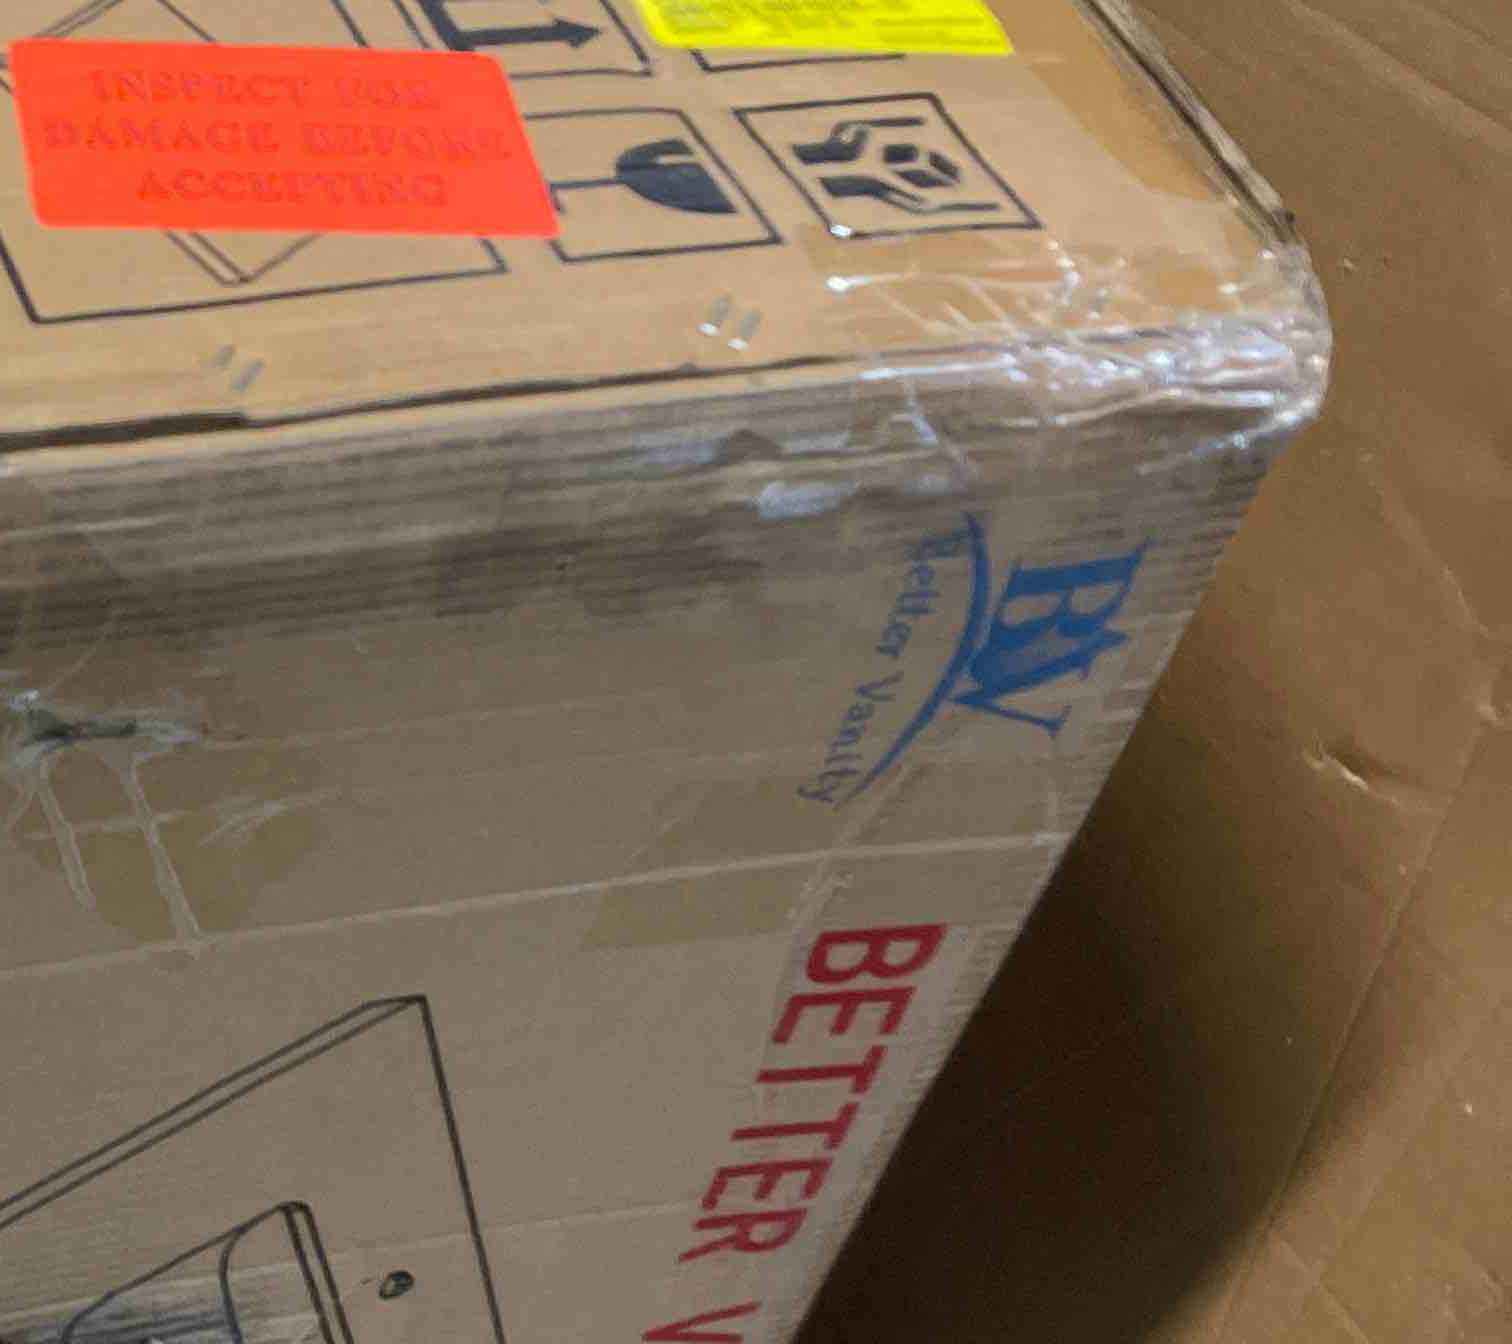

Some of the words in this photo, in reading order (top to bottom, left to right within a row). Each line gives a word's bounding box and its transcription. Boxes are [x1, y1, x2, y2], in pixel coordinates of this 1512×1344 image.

[88, 67, 310, 108] INSPECT
[334, 76, 444, 111] FOR
[42, 116, 281, 154] DAMAGE
[302, 123, 513, 162] BEFORE
[135, 167, 449, 208] ACCEPTING
[796, 670, 904, 804] Vanity
[678, 922, 947, 1264] BETTER
